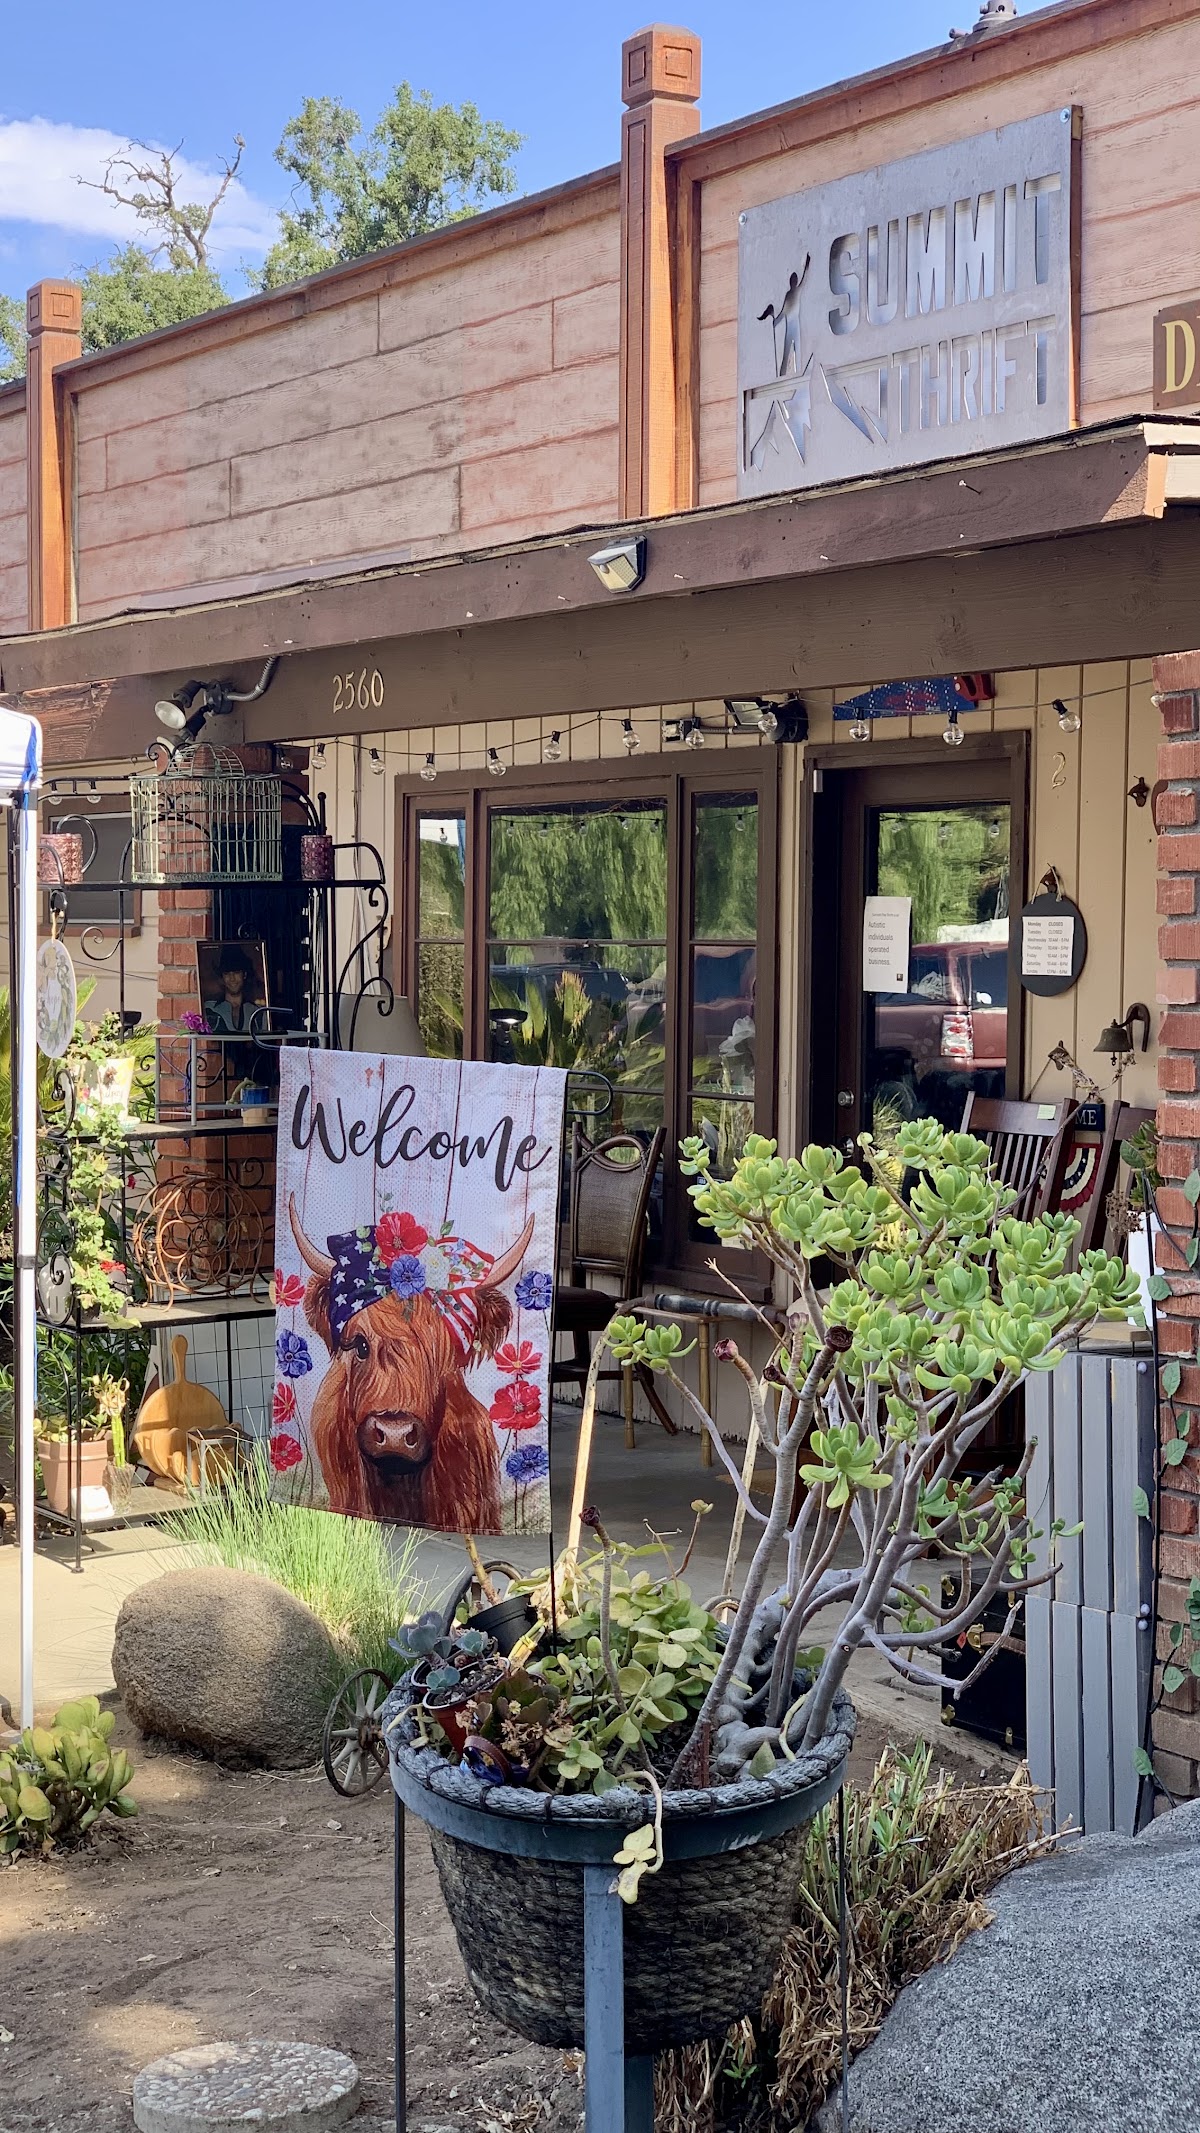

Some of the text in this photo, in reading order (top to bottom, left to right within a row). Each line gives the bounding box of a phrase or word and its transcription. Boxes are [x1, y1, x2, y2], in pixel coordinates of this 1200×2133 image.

[828, 172, 1061, 336] SUMMIT
[892, 315, 1057, 433] THRIFT
[1161, 319, 1200, 394] D
[332, 667, 384, 714] 2560
[1052, 751, 1067, 790] 2
[291, 1083, 553, 1193] Welcome
